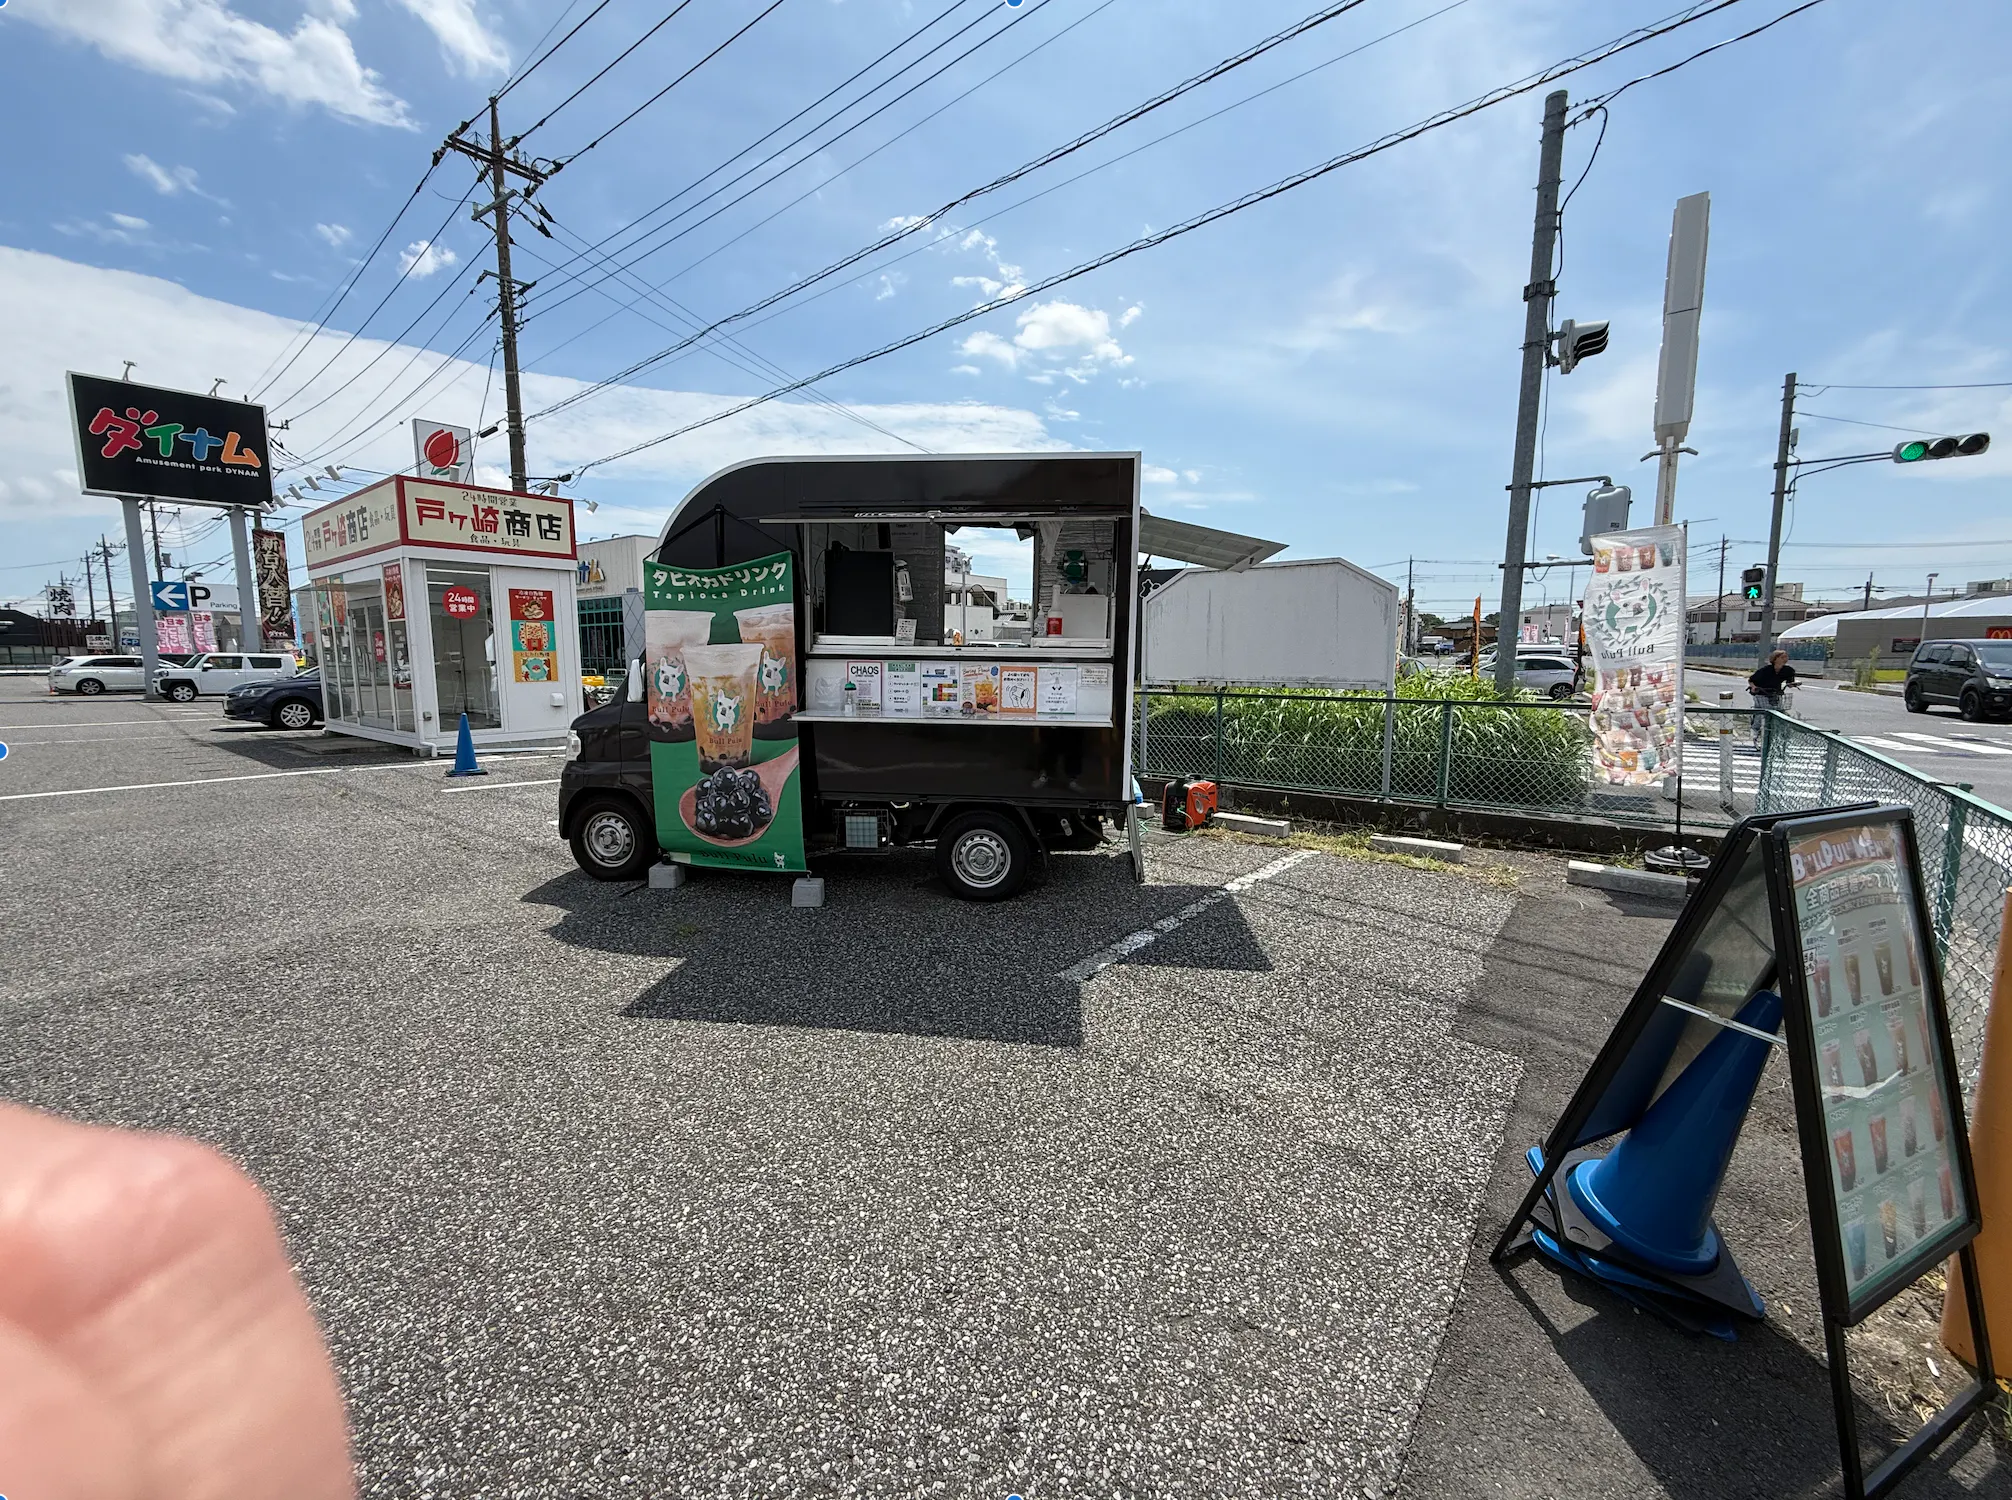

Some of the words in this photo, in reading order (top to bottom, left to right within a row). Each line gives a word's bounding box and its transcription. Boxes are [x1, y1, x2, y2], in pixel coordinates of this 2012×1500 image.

[88, 407, 262, 468] ダイナム
[135, 456, 196, 470] Amusement
[199, 464, 223, 473] park
[225, 467, 260, 478] DYNAM
[461, 490, 519, 508] 24時間営業
[189, 585, 211, 608] P
[447, 592, 475, 604] 24時間
[652, 590, 728, 601] Tapioca
[740, 583, 785, 597] Drink
[50, 588, 73, 617] 焼肉
[209, 601, 238, 610] Parking
[850, 666, 879, 675] CHAOS
